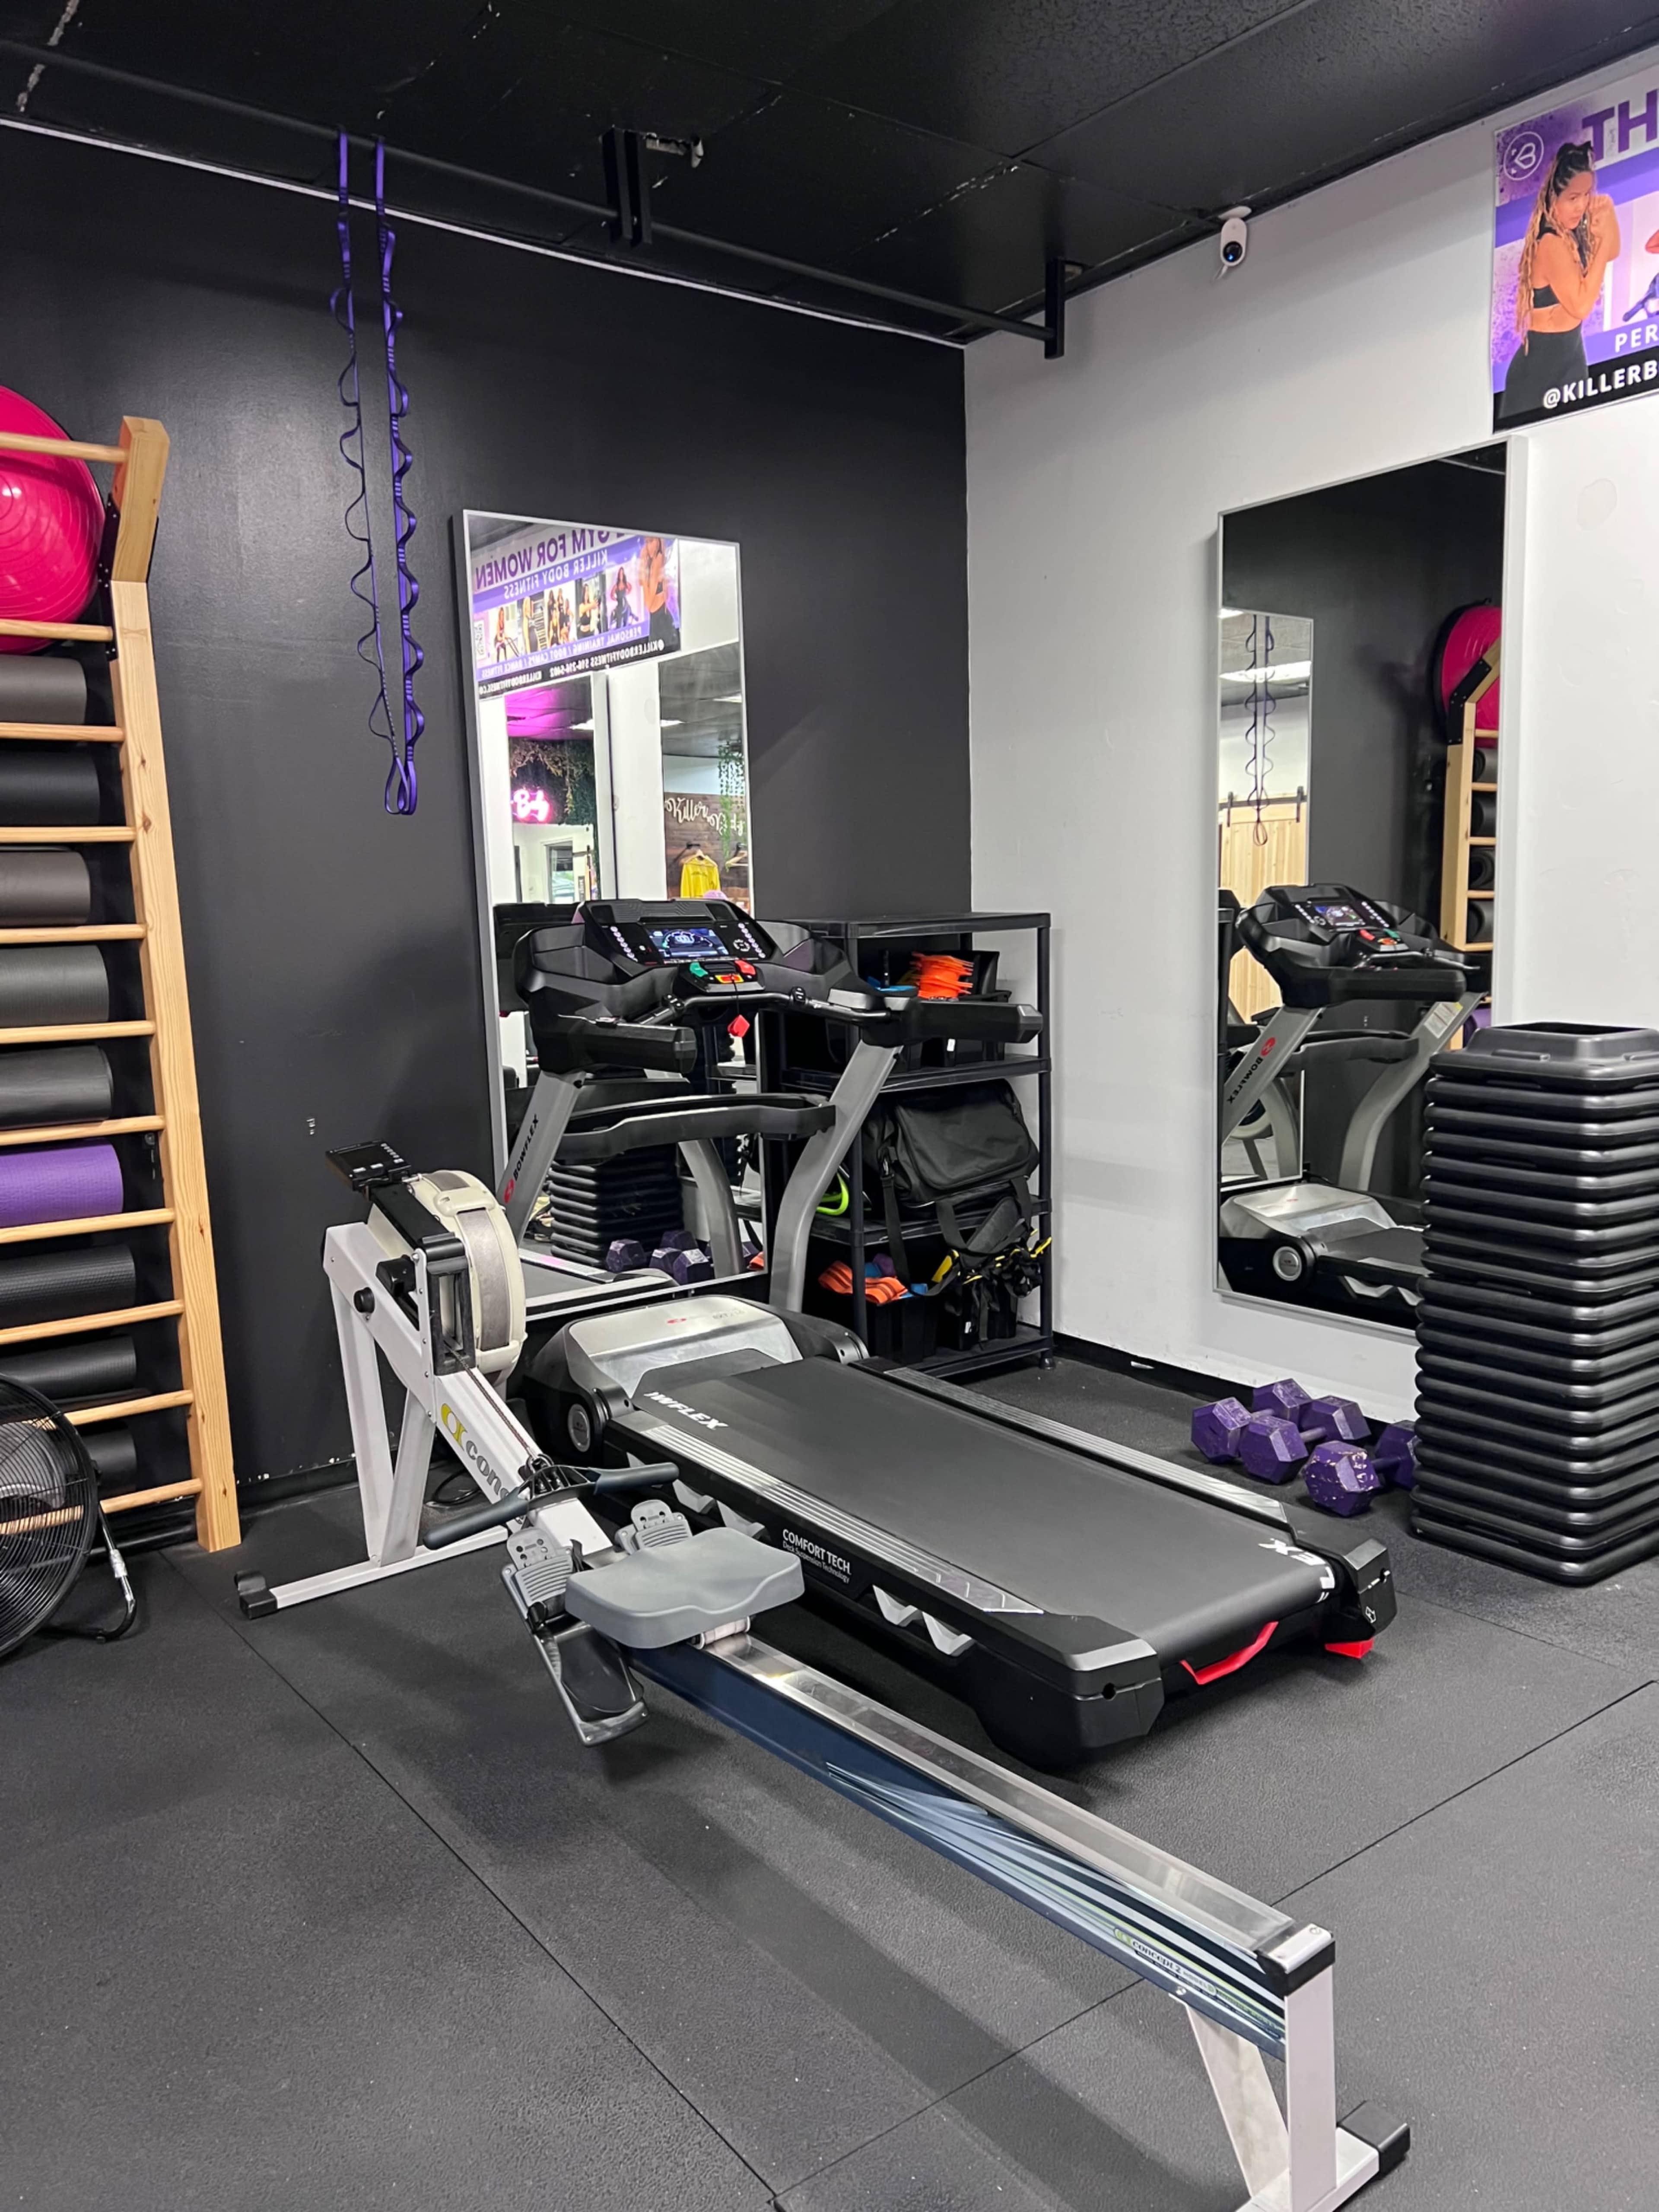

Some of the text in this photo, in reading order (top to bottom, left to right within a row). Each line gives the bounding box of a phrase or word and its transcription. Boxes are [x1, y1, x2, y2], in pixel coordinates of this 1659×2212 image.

[513, 1112, 539, 1182] BOWFLEX
[782, 1529, 850, 1574] COMFORT TECH
[822, 1561, 850, 1584] Technology
